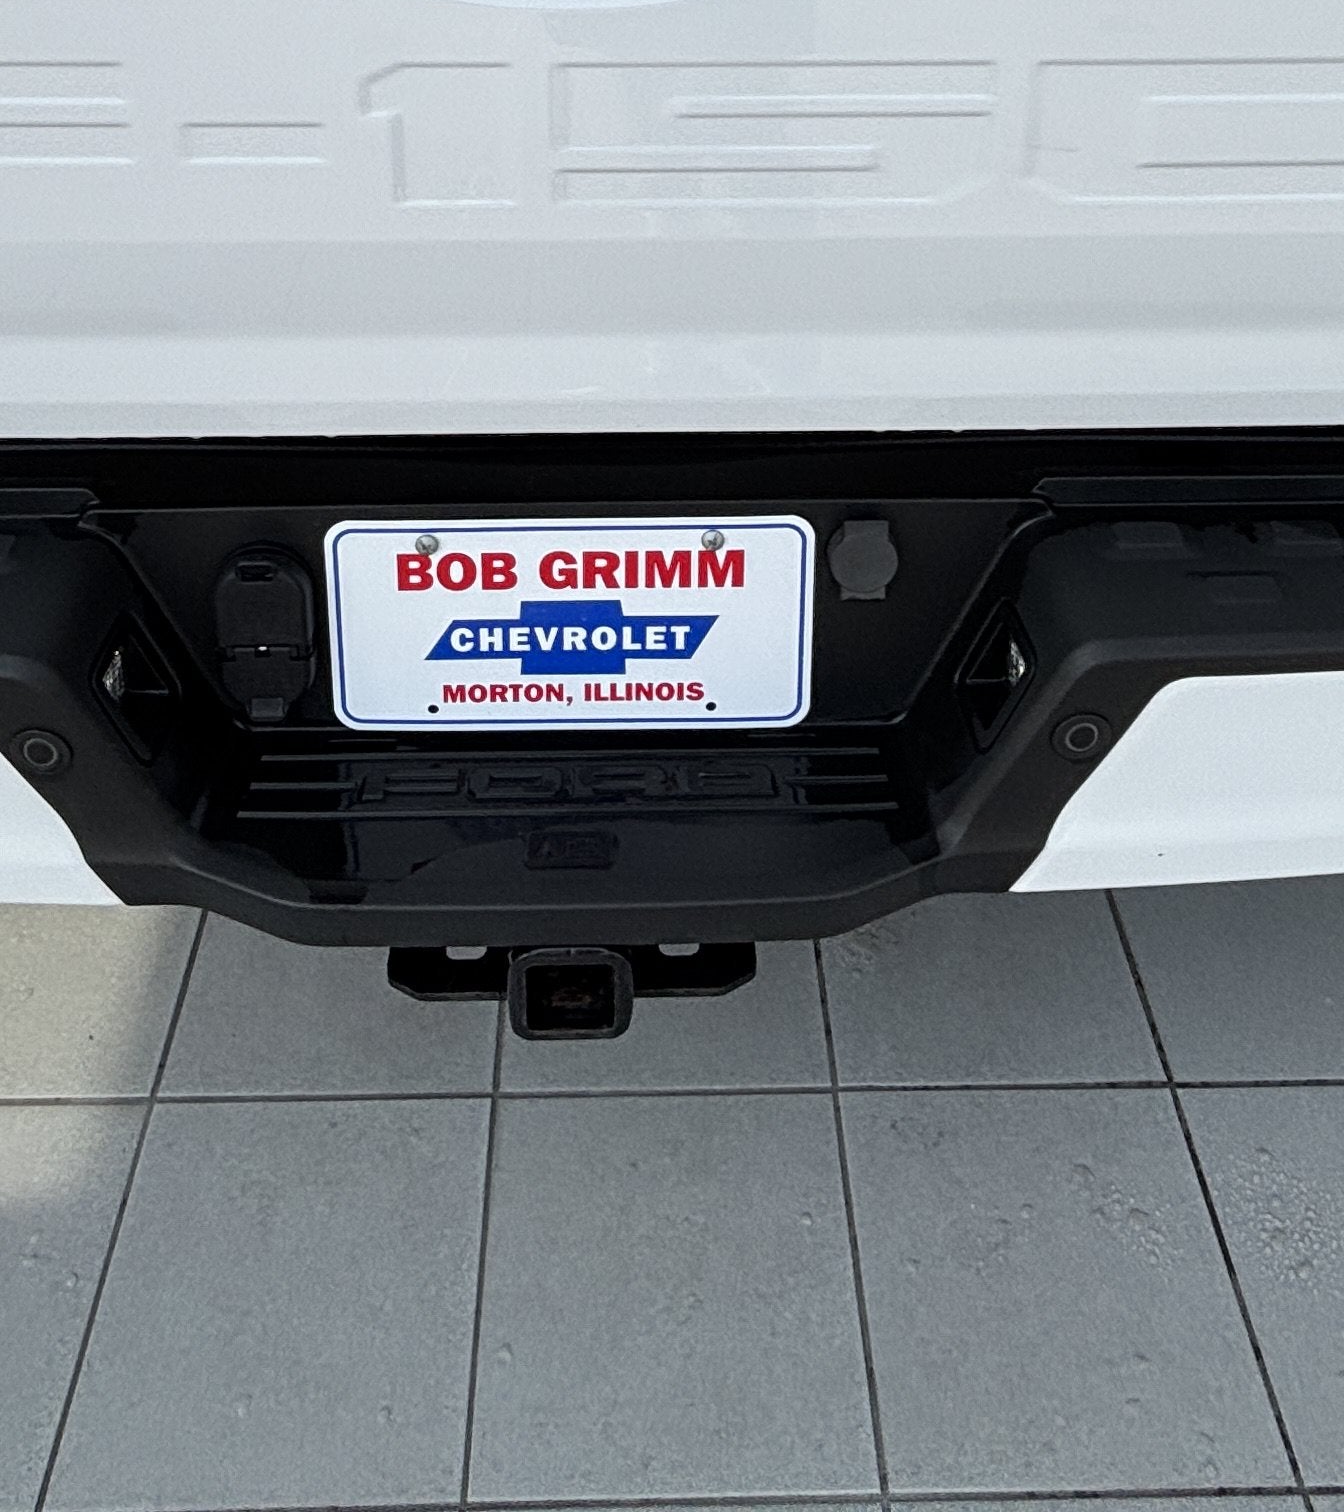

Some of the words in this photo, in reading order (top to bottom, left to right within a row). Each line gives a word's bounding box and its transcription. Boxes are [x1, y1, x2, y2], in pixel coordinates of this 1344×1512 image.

[396, 552, 518, 592] BOB
[539, 549, 746, 589] GRIMM
[449, 626, 692, 653] CHEVROLET
[442, 683, 574, 705] MORTON,
[583, 682, 705, 701] ILLINOIS
[360, 764, 780, 801] FORD
